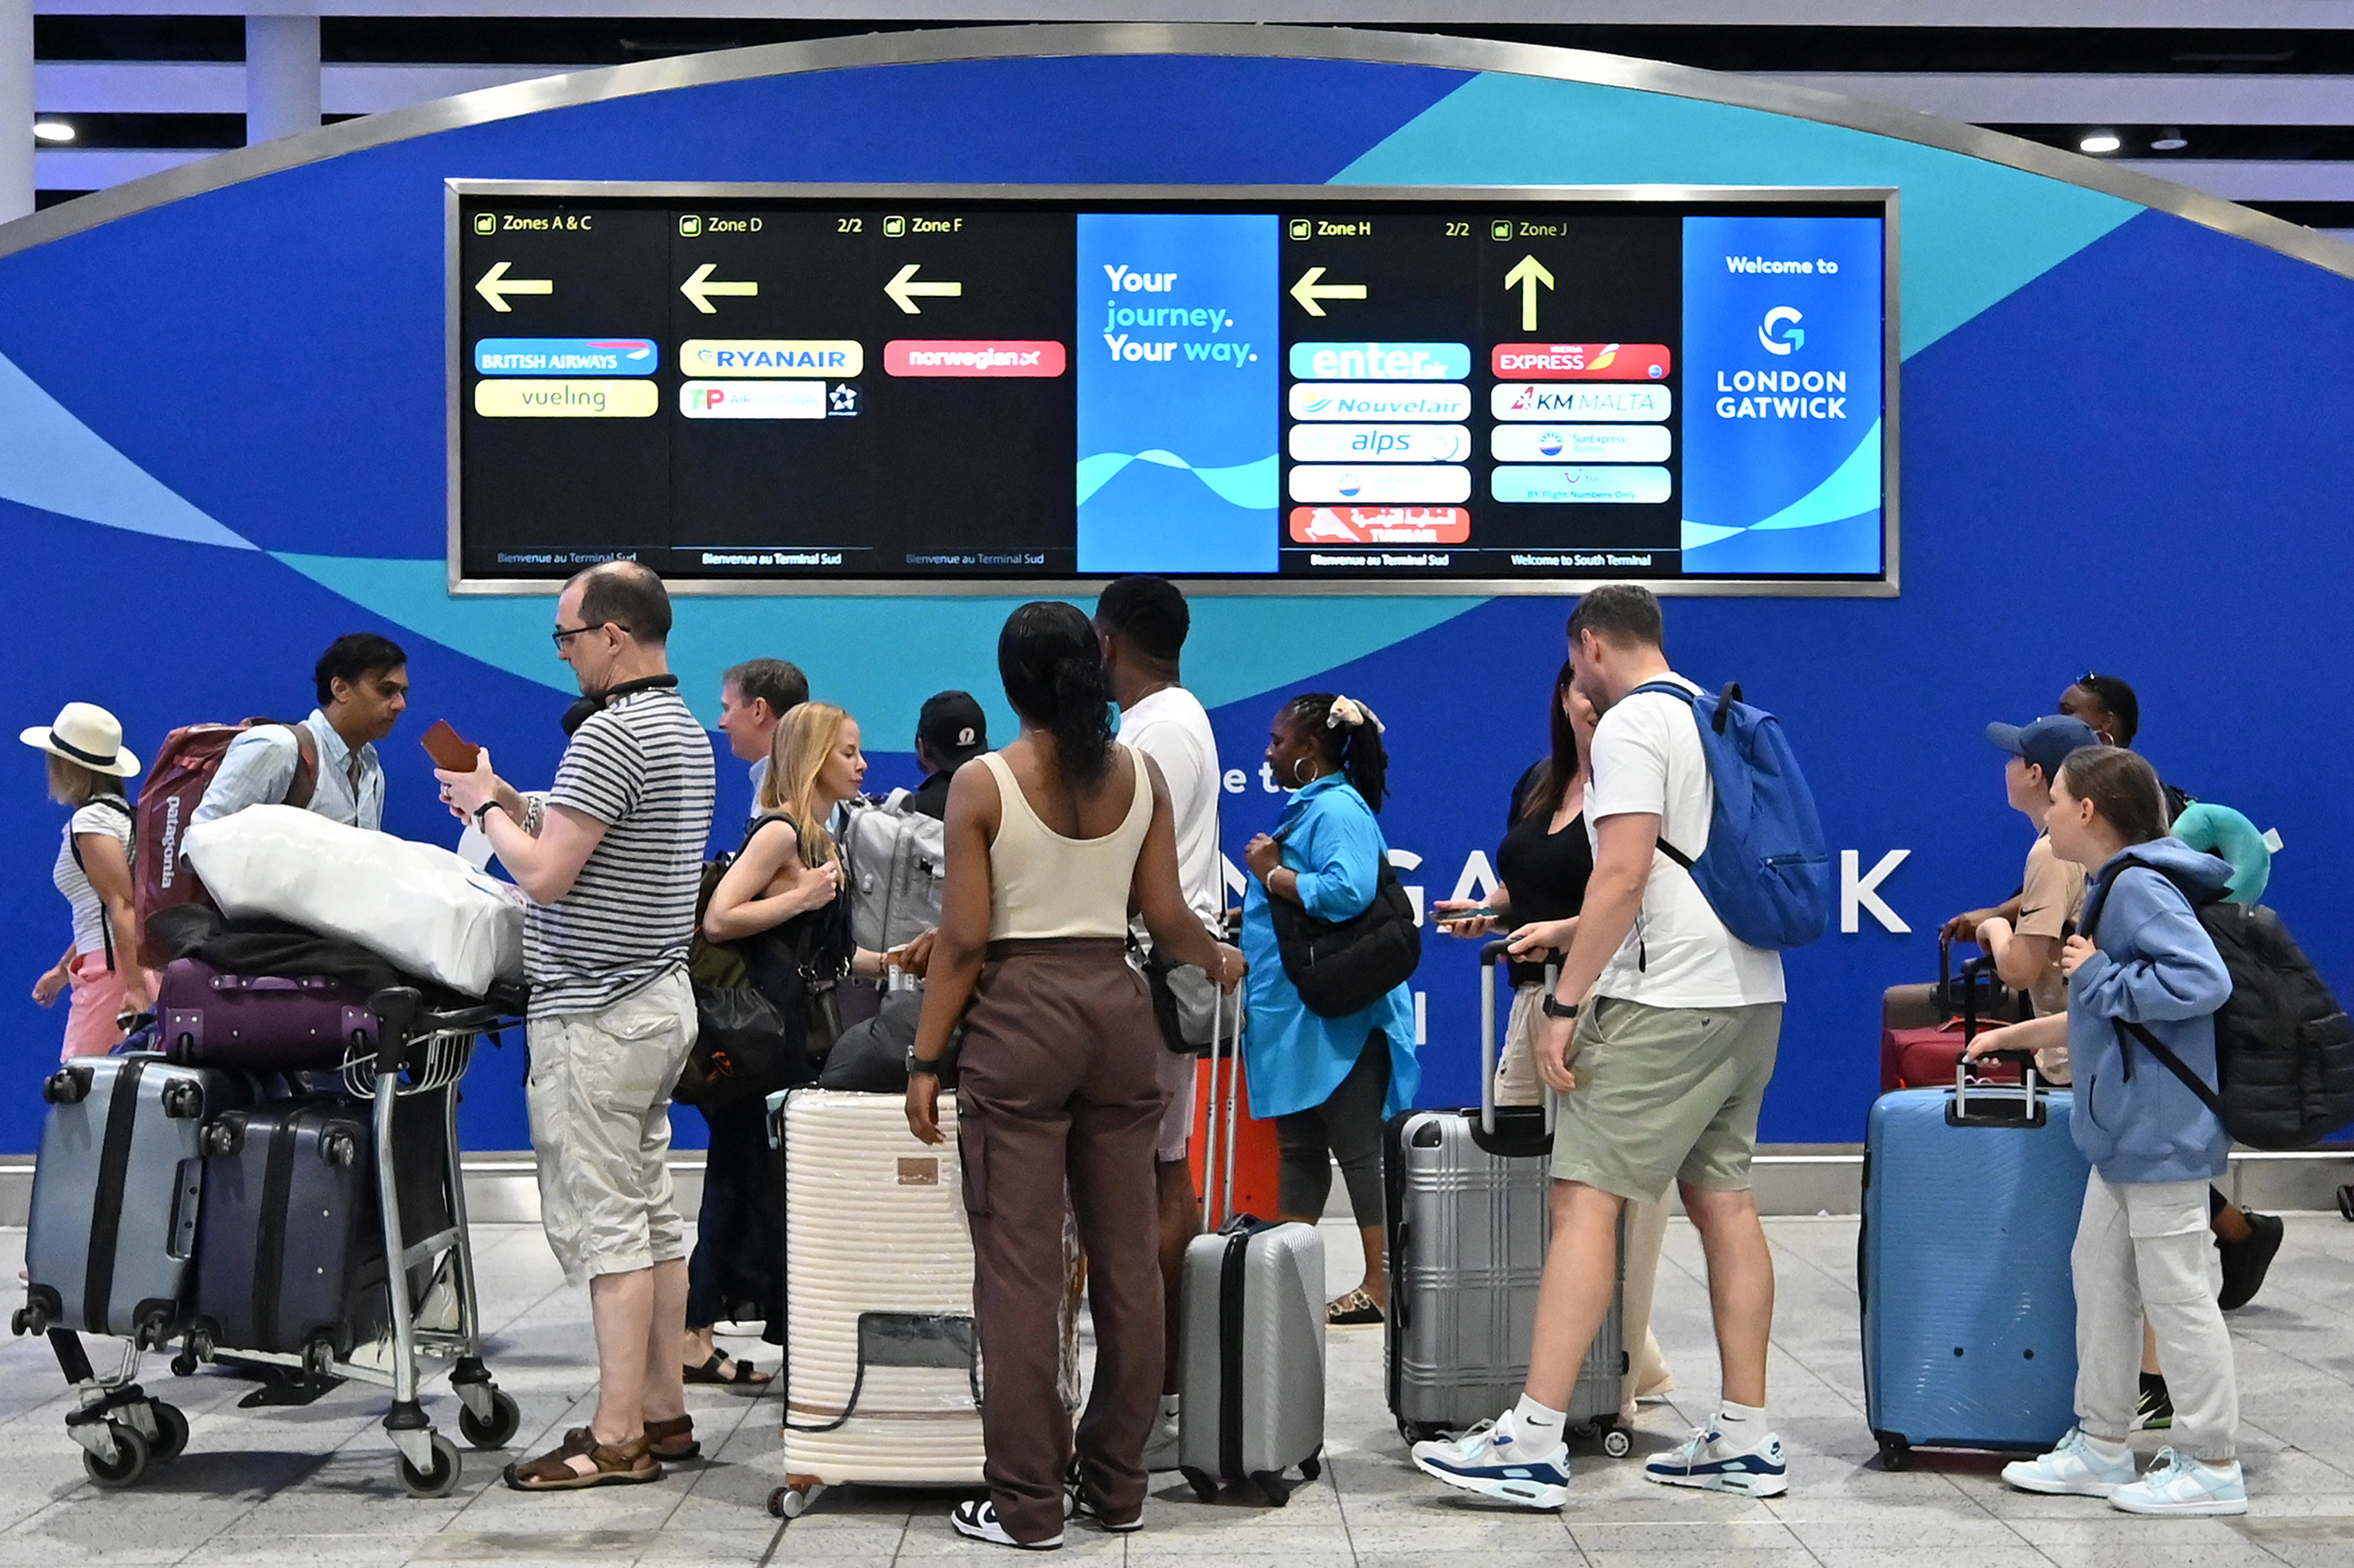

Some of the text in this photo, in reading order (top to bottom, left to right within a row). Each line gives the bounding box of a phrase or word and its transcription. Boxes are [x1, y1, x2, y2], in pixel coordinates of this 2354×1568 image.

[503, 215, 592, 230] Zones A & C
[709, 217, 763, 232] Zone D
[837, 218, 863, 232] 2/2
[912, 218, 963, 232] Zone F
[1318, 220, 1371, 236] Zone H
[1446, 222, 1470, 236] 2/2
[1519, 222, 1567, 236] Zone J
[1726, 255, 1838, 275] Welcome to
[1103, 264, 1177, 292] Your
[1103, 299, 1233, 333] journey.
[1103, 333, 1258, 368] Your way.
[482, 354, 618, 369] BRITISH AIRWAYS
[717, 351, 846, 368] RYANAIR
[909, 348, 1018, 370] norwegian
[1313, 343, 1431, 379] enter
[1500, 355, 1584, 370] EXPRESS
[1717, 370, 1846, 392] LONDON
[522, 384, 606, 412] vueling
[1536, 394, 1654, 411] KM MALTA
[1337, 399, 1462, 413] Nouvelair
[1716, 396, 1847, 419] GATWICK
[1570, 490, 1613, 499] Numbers
[498, 552, 552, 563] Bienvenue
[553, 554, 568, 563] au
[568, 552, 615, 564] Terminal
[701, 552, 842, 564] Bienvenue au Terminal Sud
[962, 555, 975, 564] au
[976, 553, 1022, 564] Terminal
[1023, 553, 1044, 564] Sud
[1511, 554, 1652, 566] Welcome to South Terminal
[162, 796, 180, 888] patagonia
